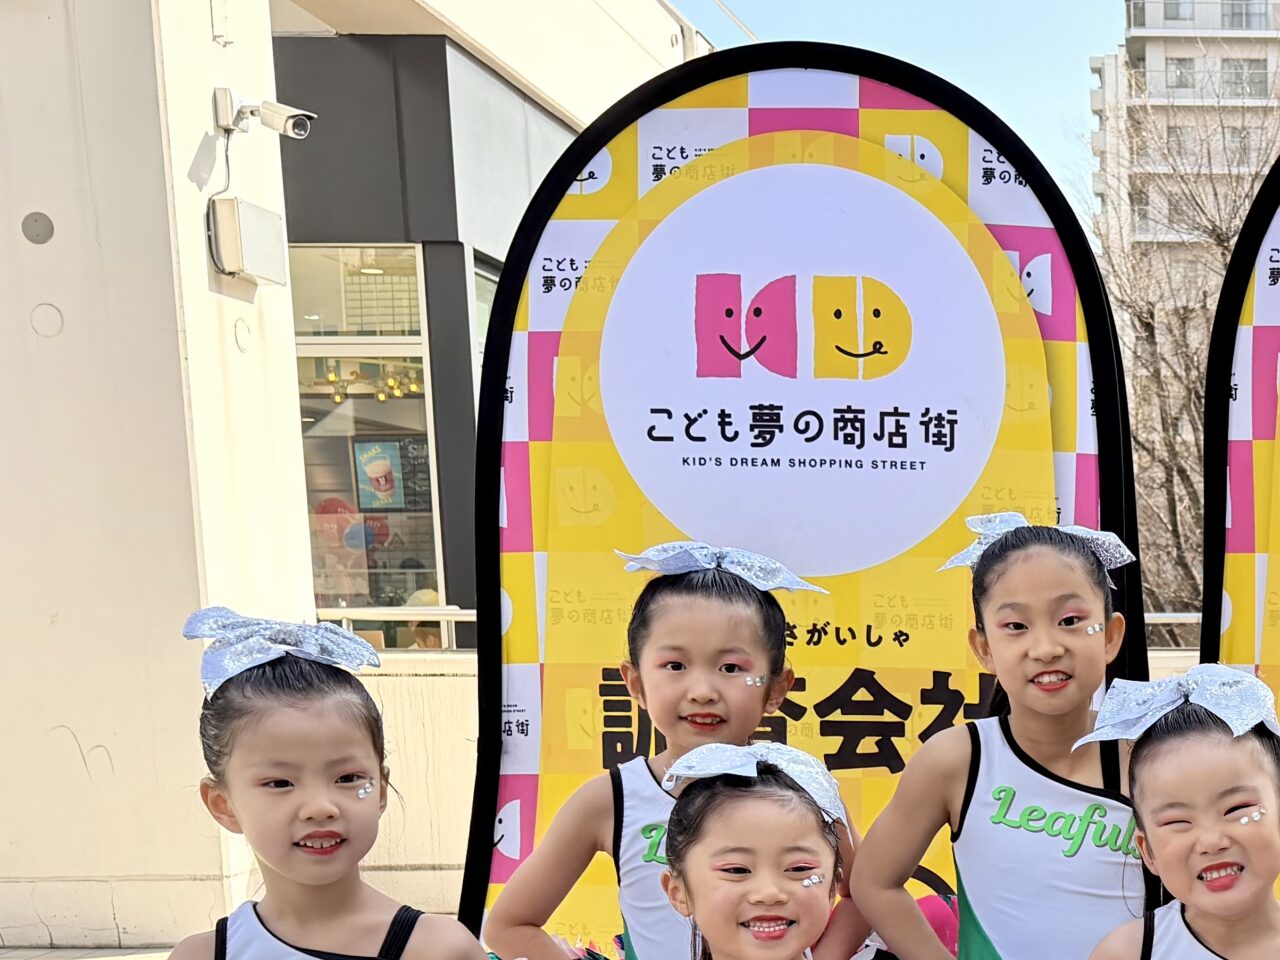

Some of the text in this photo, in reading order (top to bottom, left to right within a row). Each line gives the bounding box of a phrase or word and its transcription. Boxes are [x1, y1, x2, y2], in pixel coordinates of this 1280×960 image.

[647, 403, 958, 453] こども夢の商店街
[682, 457, 927, 471] KID'S DREAM SHOPPING STREET
